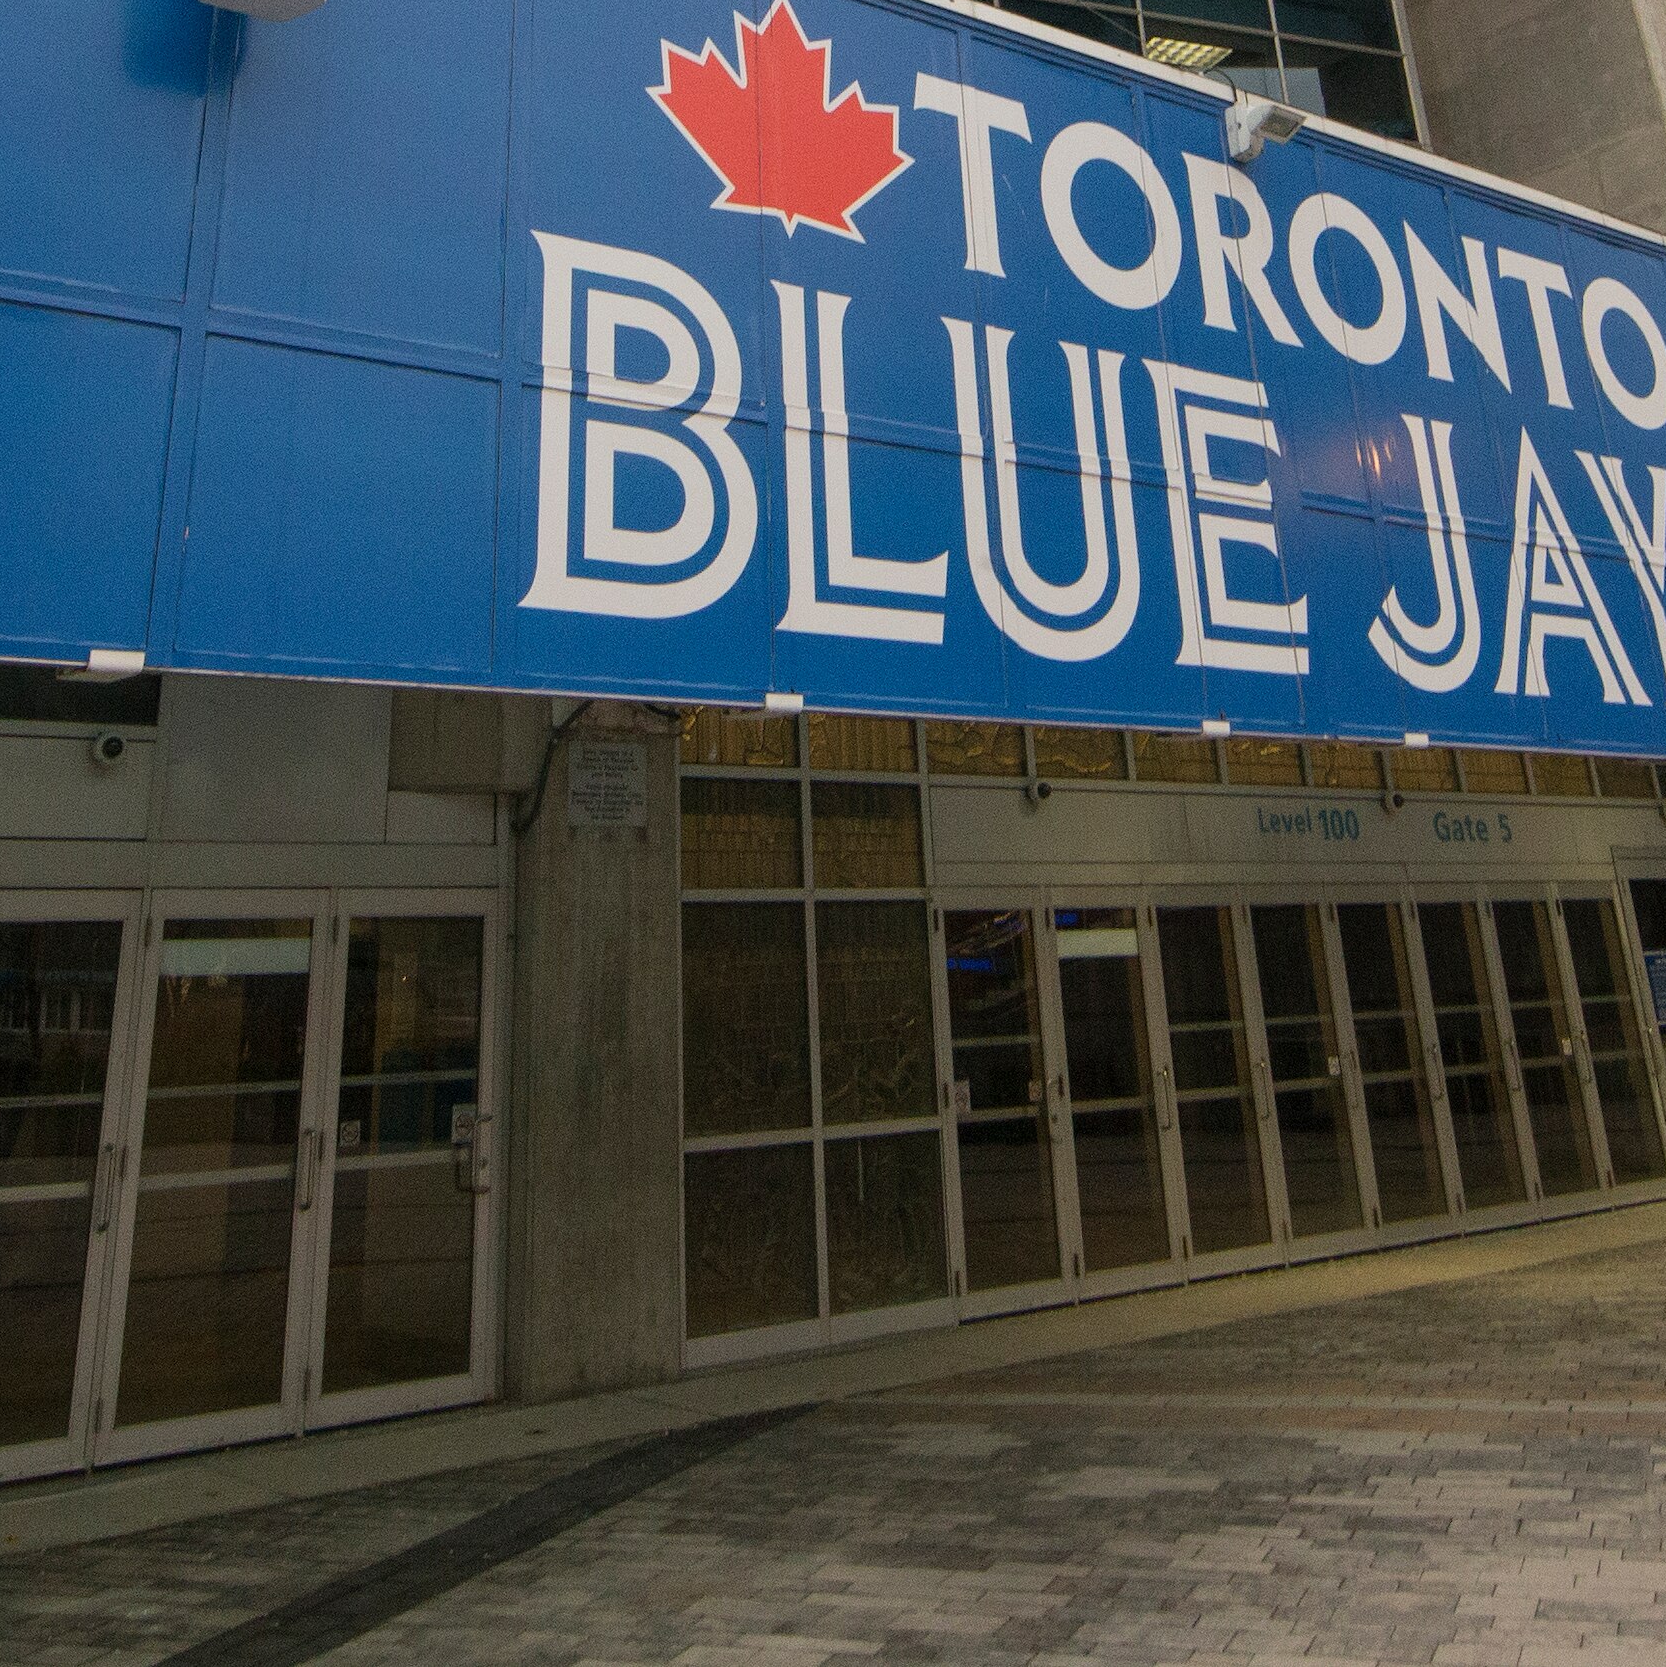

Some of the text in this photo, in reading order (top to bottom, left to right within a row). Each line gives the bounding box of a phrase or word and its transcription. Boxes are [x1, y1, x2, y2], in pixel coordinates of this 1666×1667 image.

[519, 230, 1309, 675] BLUE
[1257, 805, 1359, 841] Level 100
[1434, 809, 1513, 843] Gate 5
